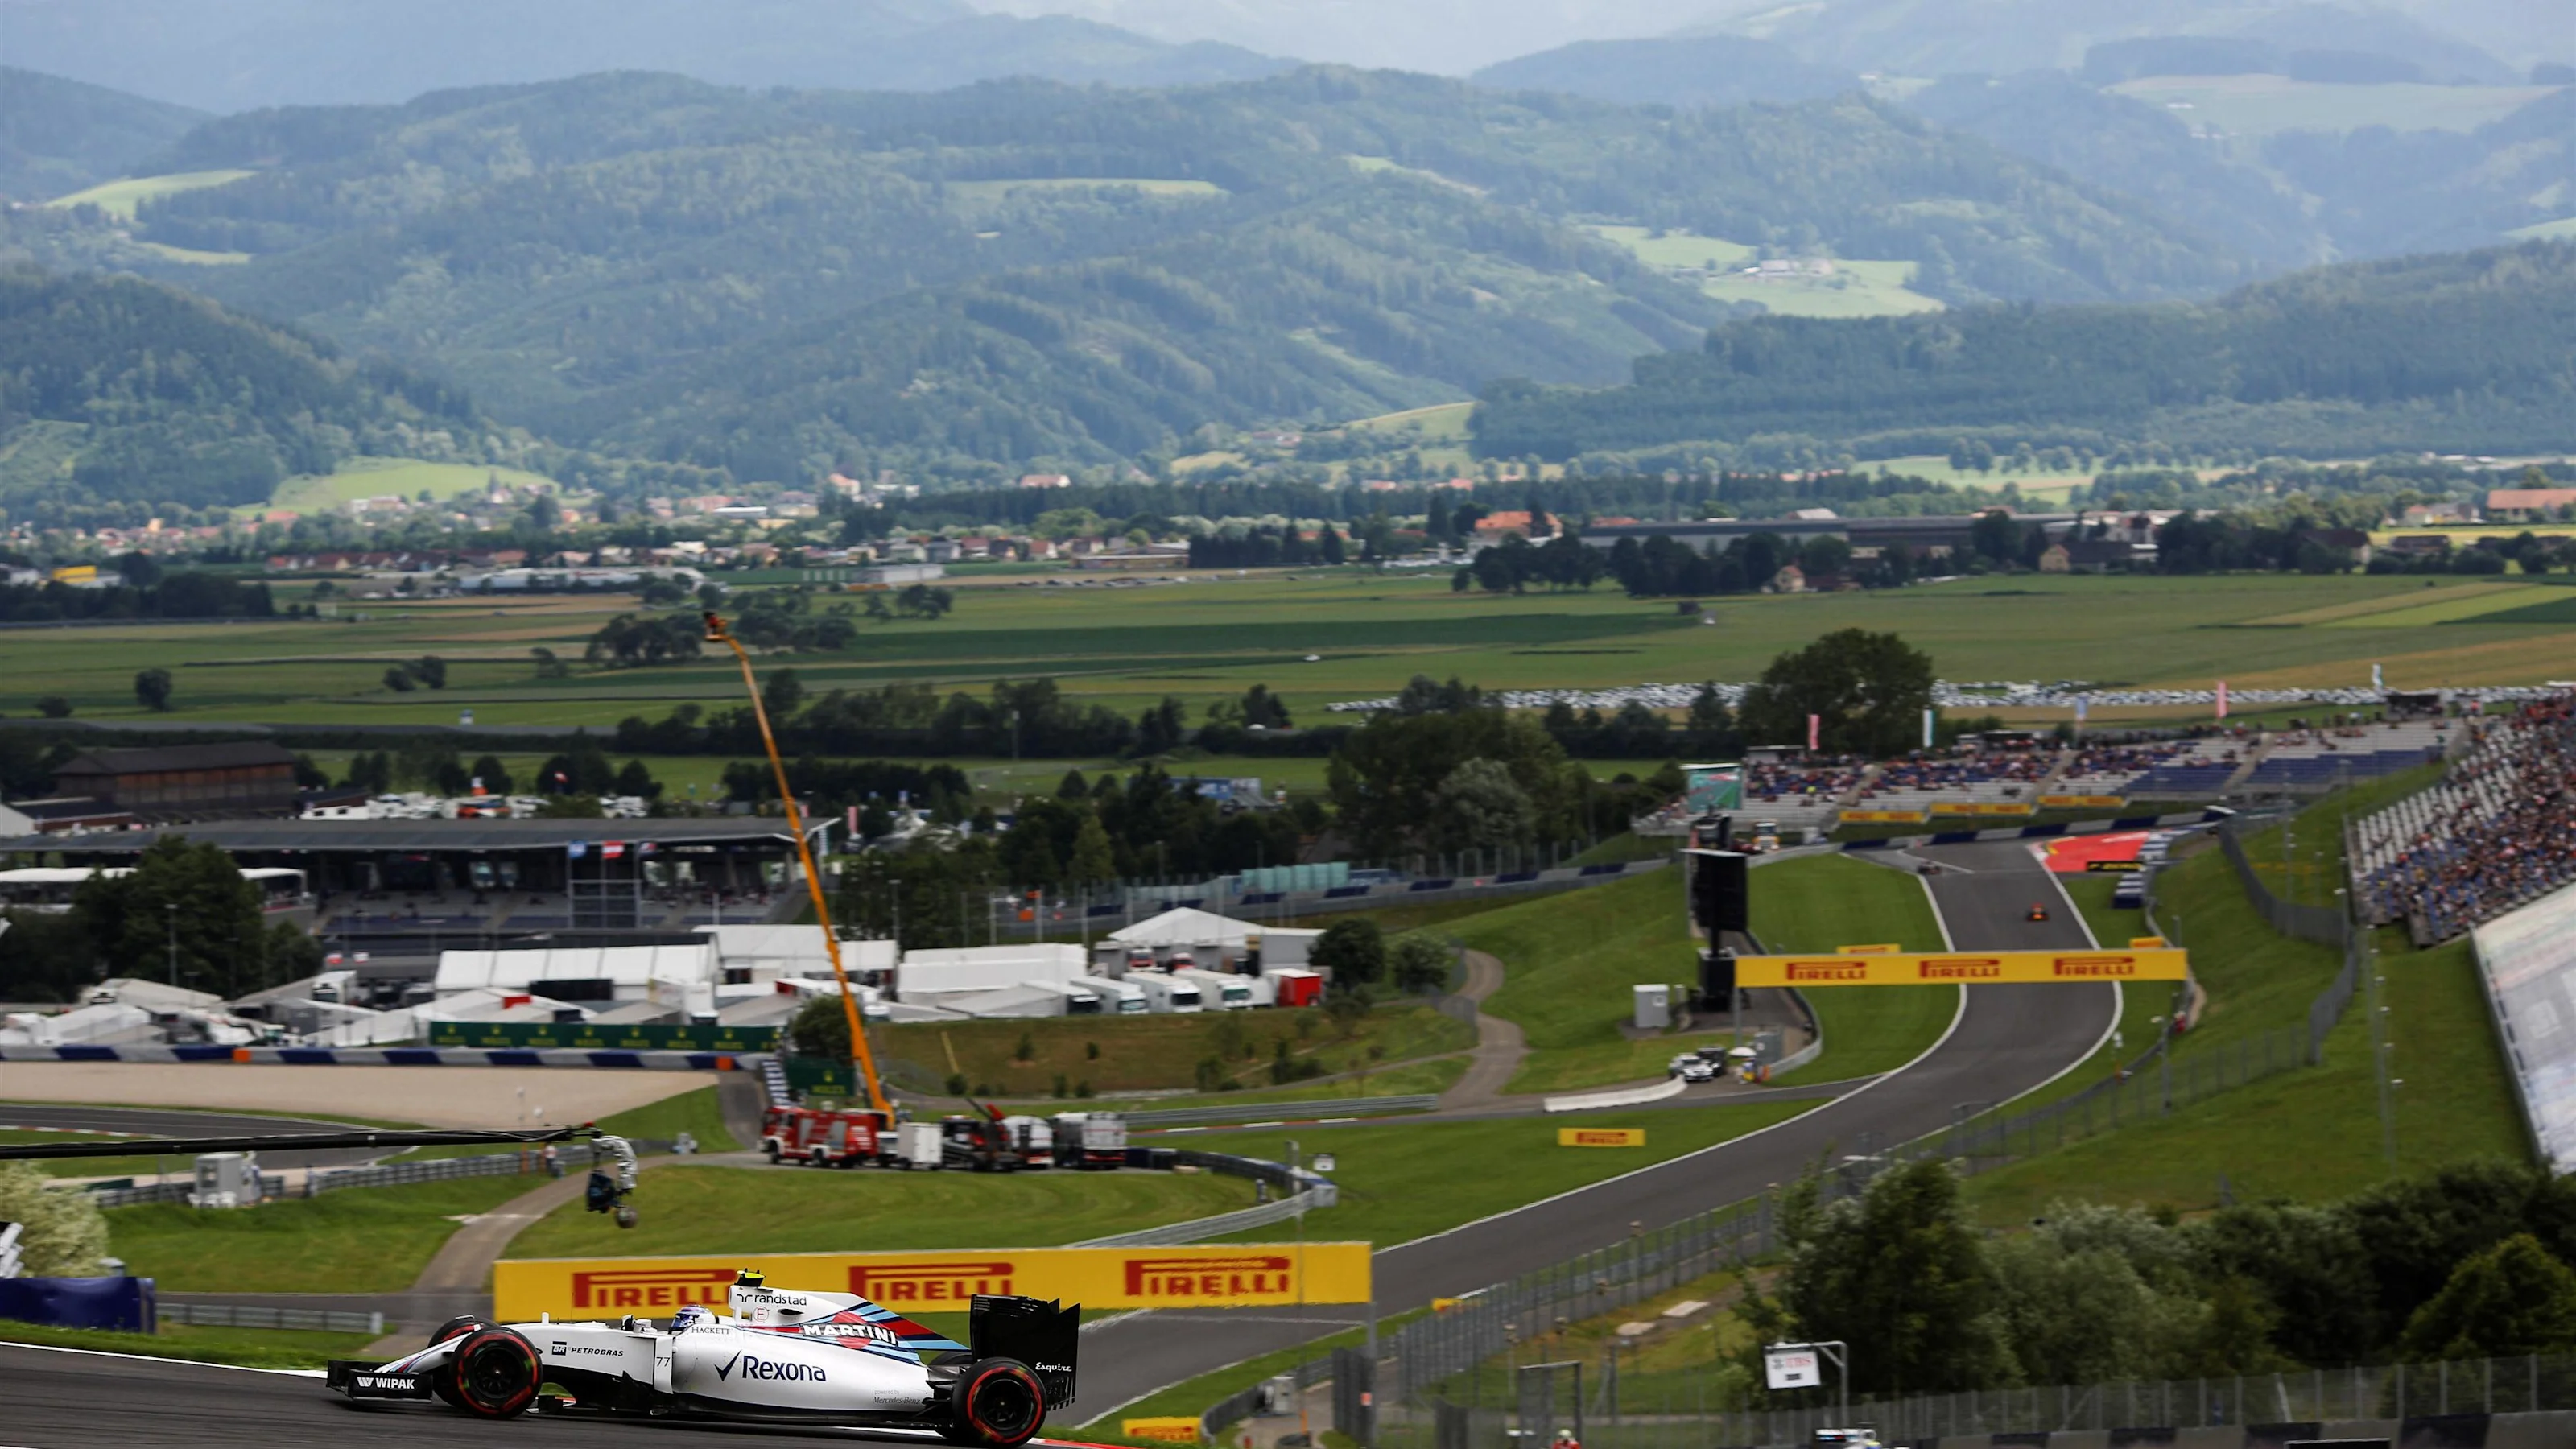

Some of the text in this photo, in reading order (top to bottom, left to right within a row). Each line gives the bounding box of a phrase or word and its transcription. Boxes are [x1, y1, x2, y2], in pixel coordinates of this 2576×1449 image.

[1786, 961, 1866, 980] PIRELLI
[1919, 959, 2001, 978] PIRELLI
[2055, 957, 2135, 975] PIRELLI
[1125, 1257, 1290, 1296] PIRELLI
[754, 1294, 807, 1306] randstad
[691, 1327, 730, 1335] HACKETT
[803, 1324, 898, 1345] MARTINI
[571, 1347, 624, 1357] PETROBRAS
[656, 1357, 671, 1367] 77
[1035, 1362, 1072, 1372] Esquire
[742, 1356, 827, 1381] Rexona
[376, 1377, 415, 1389] WIPAK
[873, 1396, 921, 1405] Mercedes-Benz
